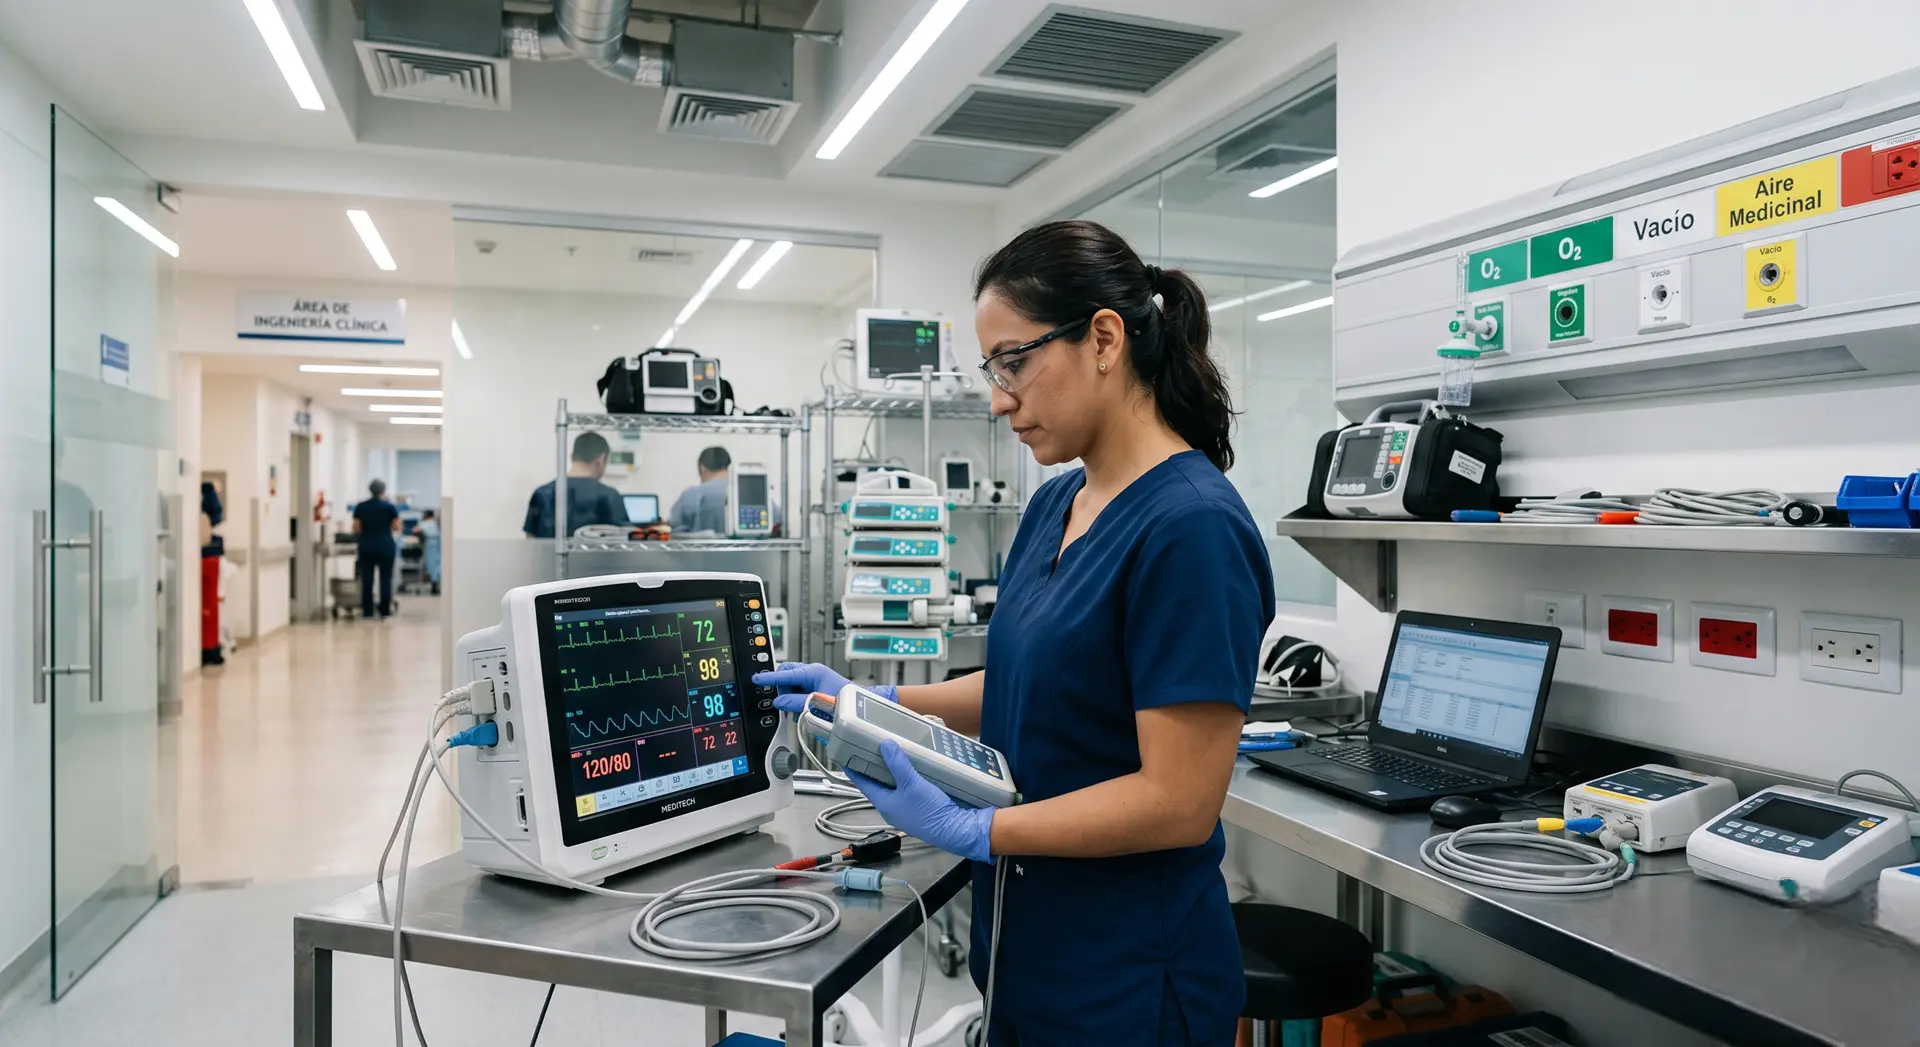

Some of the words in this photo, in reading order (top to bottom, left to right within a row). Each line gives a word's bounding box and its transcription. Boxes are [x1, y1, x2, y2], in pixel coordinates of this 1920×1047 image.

[1754, 177, 1795, 199] Aire
[1729, 189, 1823, 228] Medicinal
[1633, 209, 1695, 241] Vacío
[293, 298, 329, 314] ÁREA
[333, 302, 351, 314] DE
[254, 314, 332, 329] INGENIERÍA
[336, 317, 388, 332] CLÍNICA
[692, 619, 716, 643] 72
[699, 657, 720, 681] 98
[703, 693, 725, 718] 98
[702, 735, 716, 750] 72
[725, 731, 738, 746] 22
[582, 752, 632, 780] 120/80
[661, 797, 696, 814] MEDITECH
